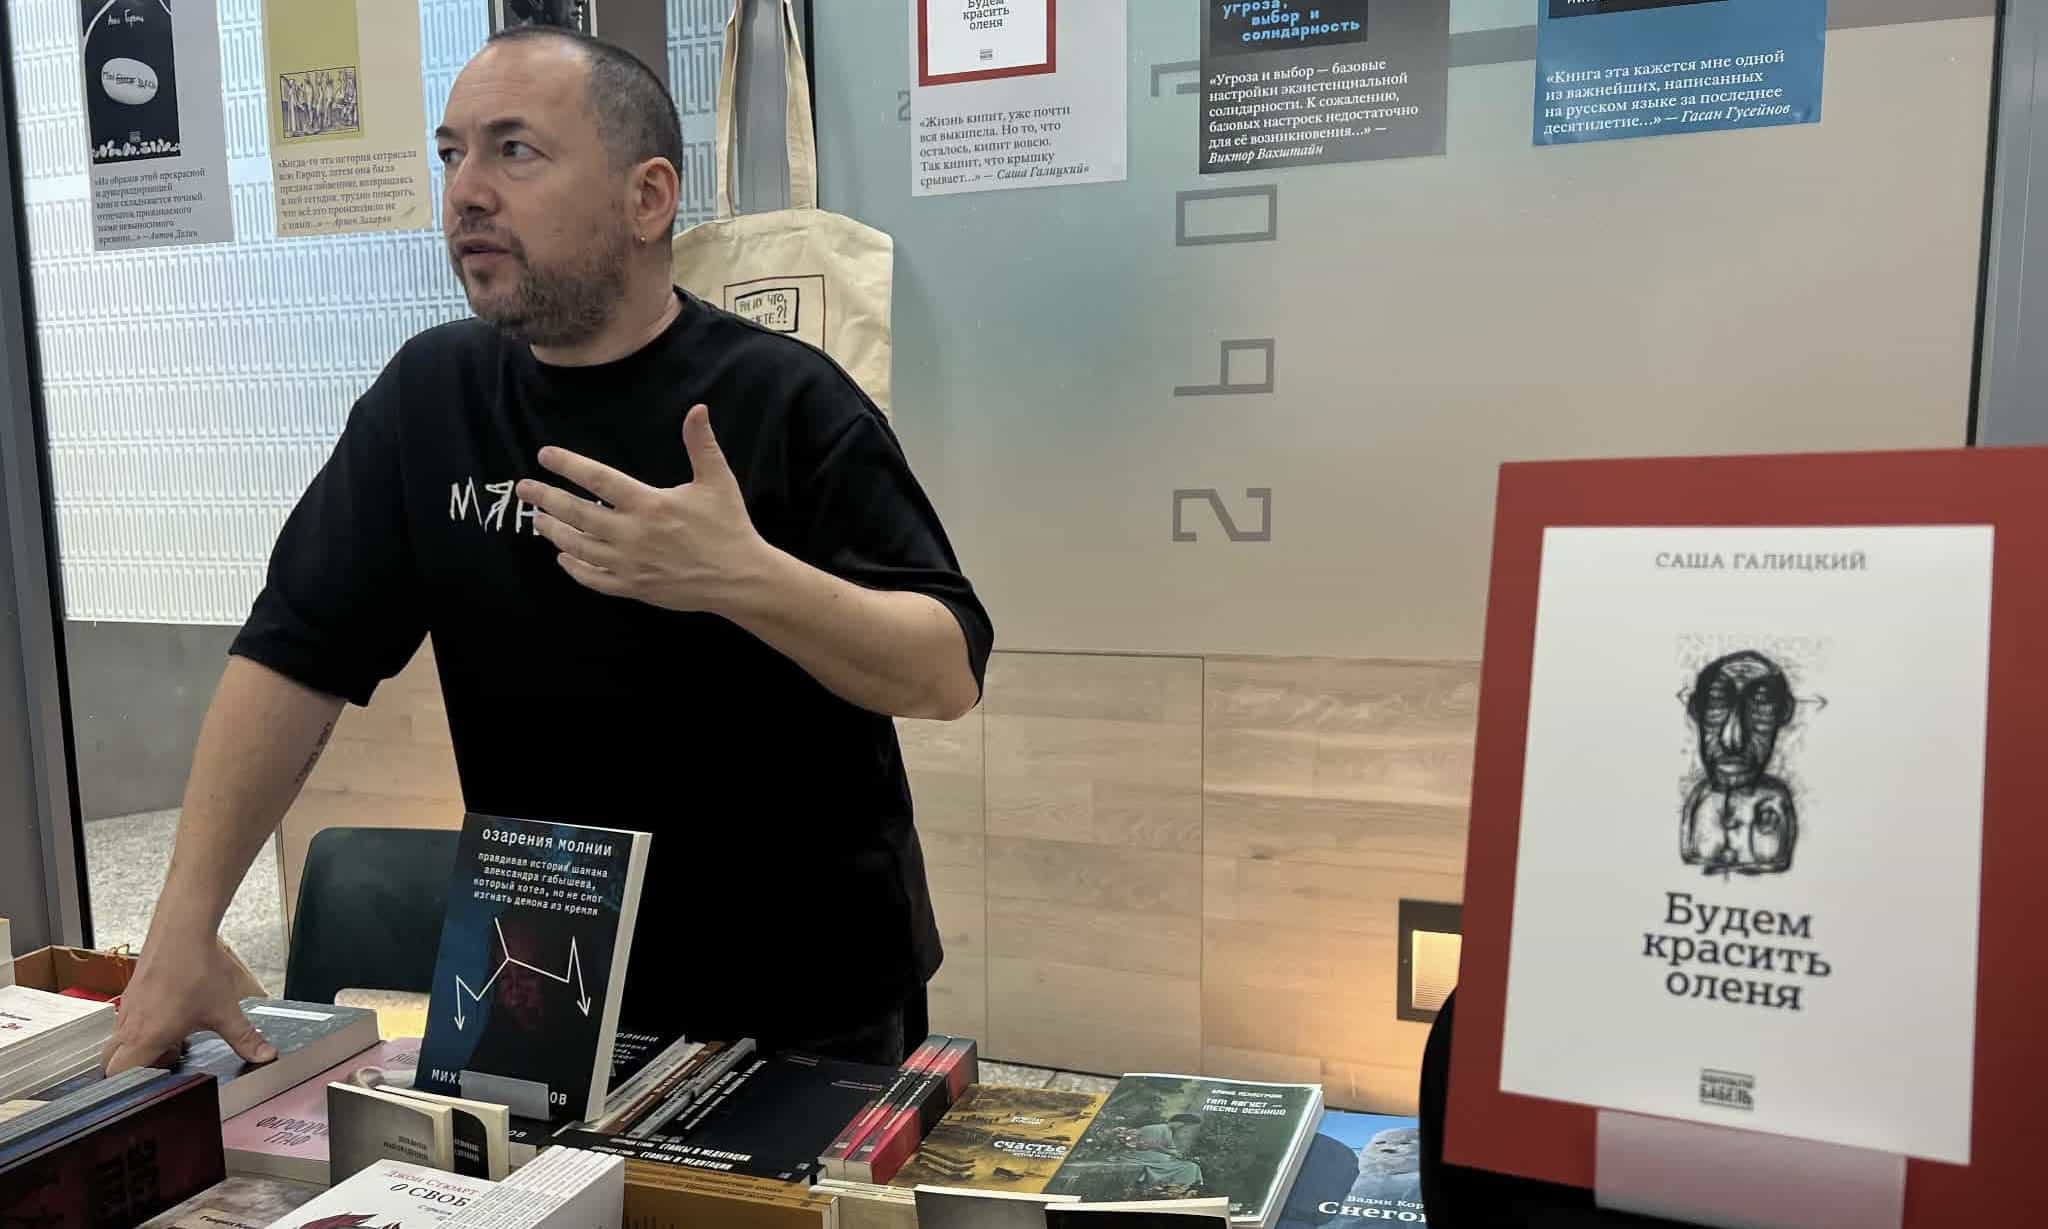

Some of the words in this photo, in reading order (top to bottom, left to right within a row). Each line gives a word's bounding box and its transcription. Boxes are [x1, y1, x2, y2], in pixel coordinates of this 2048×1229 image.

[963, 8, 1010, 21] красить
[970, 18, 1003, 30] оленя
[1251, 10, 1300, 27] выбор
[1310, 10, 1320, 20] и
[1242, 20, 1361, 42] солидарность
[1210, 73, 1258, 88] «Угроза
[1273, 66, 1314, 80] выбор
[1332, 60, 1387, 74] базовые
[1546, 69, 1601, 85] «Книга
[1605, 67, 1630, 79] эта
[1633, 61, 1697, 77] кажется
[1700, 58, 1732, 70] мне
[1735, 50, 1785, 67] одной
[1209, 83, 1279, 102] настройки
[1280, 72, 1408, 96] экзистенциальной
[1545, 91, 1563, 102] из
[1567, 80, 1661, 99] важнейших,
[1664, 72, 1764, 90] написанных
[1209, 100, 1303, 118] солидарности.
[1306, 98, 1316, 108] К
[1319, 91, 1400, 108] сожалению,
[1545, 107, 1562, 118] на
[1566, 102, 1627, 120] русском
[1631, 97, 1677, 110] языке
[1680, 95, 1697, 106] за
[1700, 87, 1784, 105] последнее
[1680, 109, 1722, 123] Гасан
[1725, 103, 1792, 121] Гусейнов
[920, 114, 964, 128] «Жизнь
[967, 111, 1004, 126] кипит,
[1009, 109, 1031, 123] уже
[1033, 105, 1070, 119] почти
[1209, 119, 1261, 133] базовых
[1263, 113, 1322, 129] настроек
[1325, 105, 1419, 124] недостаточно
[920, 132, 937, 143] вся
[940, 126, 998, 142] выкипела.
[1002, 124, 1018, 136] Но
[1021, 125, 1037, 135] то,
[1040, 122, 1061, 133] что
[1209, 137, 1232, 150] для
[1233, 132, 1248, 146] её
[920, 143, 972, 158] осталось,
[974, 139, 1012, 153] кипит
[1014, 137, 1051, 149] вовсю.
[1208, 149, 1254, 164] Виктор
[1256, 143, 1324, 161] Вахштайн
[920, 159, 939, 172] Так
[943, 156, 982, 170] кипит,
[984, 156, 1004, 166] что
[1007, 151, 1055, 166] крышку
[997, 166, 1026, 179] Саша
[1655, 552, 1725, 570] САША
[1732, 551, 1867, 573] ГАЛИЦКИЙ
[482, 828, 553, 849] озарения
[558, 838, 613, 857] молнии
[478, 852, 528, 867] правдивая
[530, 859, 569, 873] история
[571, 865, 608, 878] шамана
[483, 865, 539, 881] александра
[542, 873, 596, 891] габышева,
[473, 878, 515, 891] который
[518, 884, 549, 897] хотел,
[553, 889, 564, 898] но
[567, 891, 578, 900] не
[580, 893, 603, 904] смог
[473, 890, 513, 904] изгнать
[514, 897, 548, 909] демона
[550, 901, 562, 911] из
[564, 902, 600, 917] кремля
[1665, 892, 1812, 940] Будем
[1642, 930, 1832, 979] красить
[1665, 970, 1803, 1012] оленя
[993, 1140, 1067, 1153] счастье
[390, 1183, 408, 1192] О
[409, 1185, 472, 1208] СВОБ
[1345, 1195, 1392, 1206] Вадик
[1397, 1200, 1424, 1210] Кор
